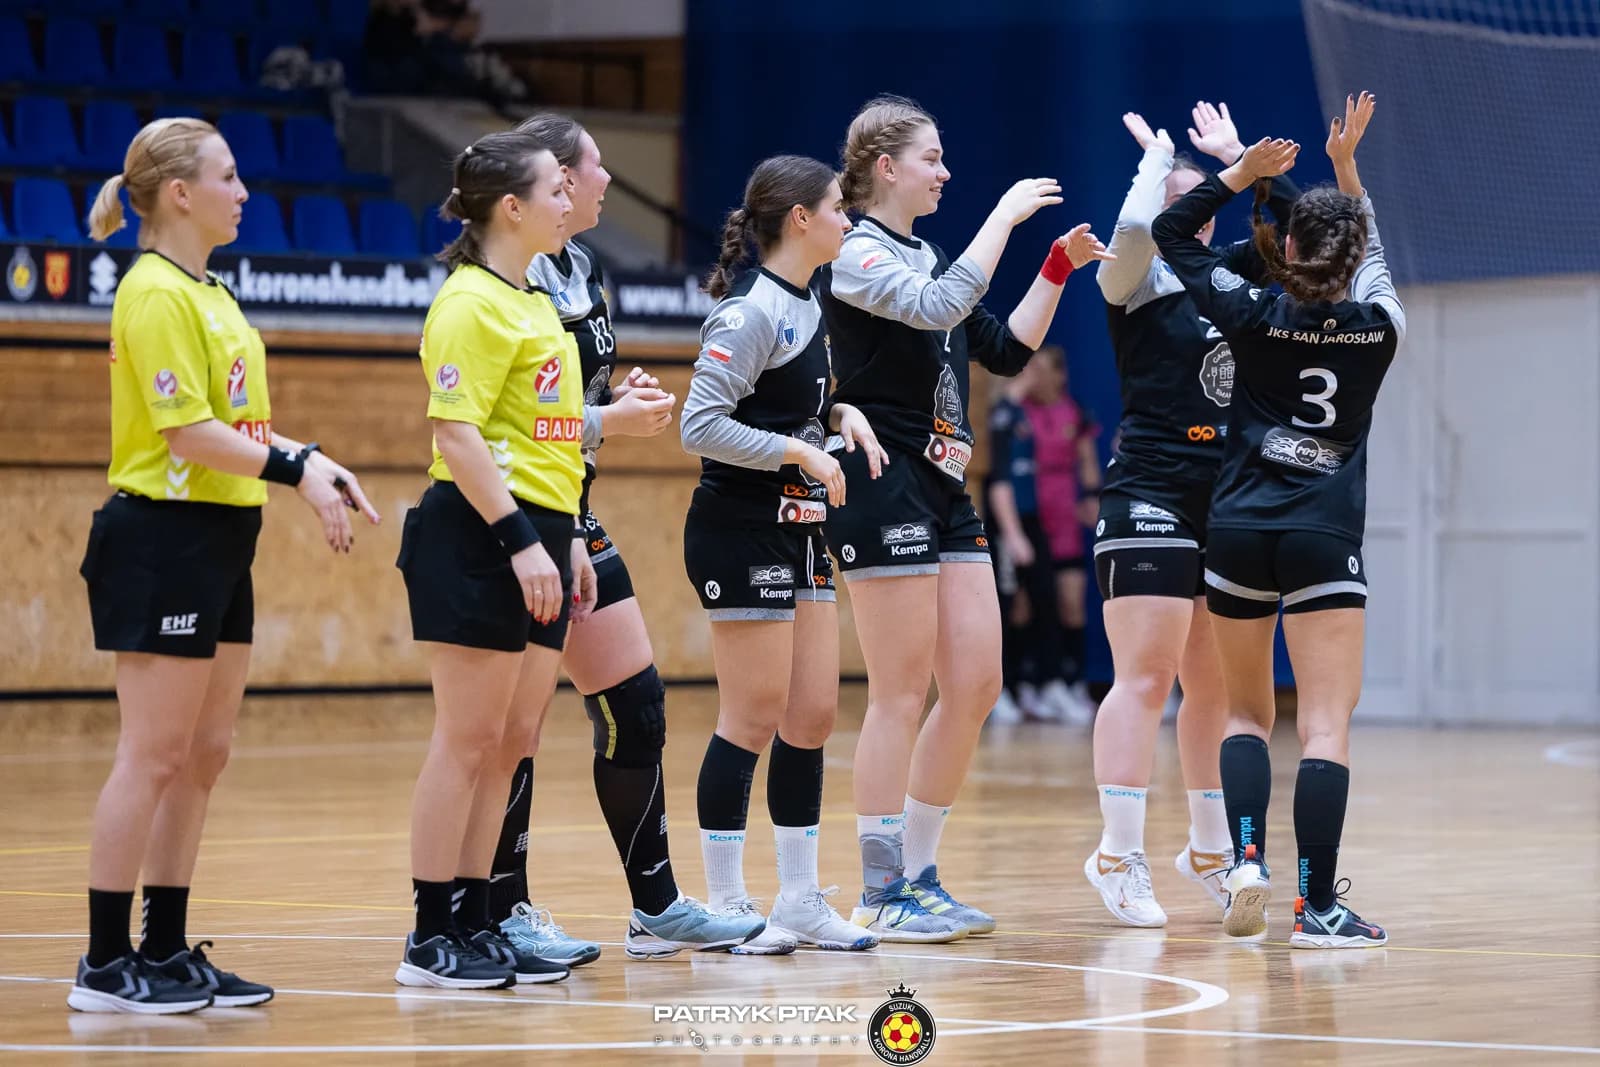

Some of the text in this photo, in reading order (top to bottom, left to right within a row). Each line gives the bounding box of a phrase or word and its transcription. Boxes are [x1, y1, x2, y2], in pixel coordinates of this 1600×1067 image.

[587, 316, 614, 356] 83
[1266, 326, 1385, 344] JKS SAN JAROSŁAW
[816, 377, 826, 416] 7
[1291, 367, 1338, 428] 3
[1135, 521, 1175, 534] Kempa
[891, 543, 929, 556] Kempa
[760, 587, 793, 600] Kempa
[161, 612, 199, 630] EHF
[1299, 858, 1312, 898] empa
